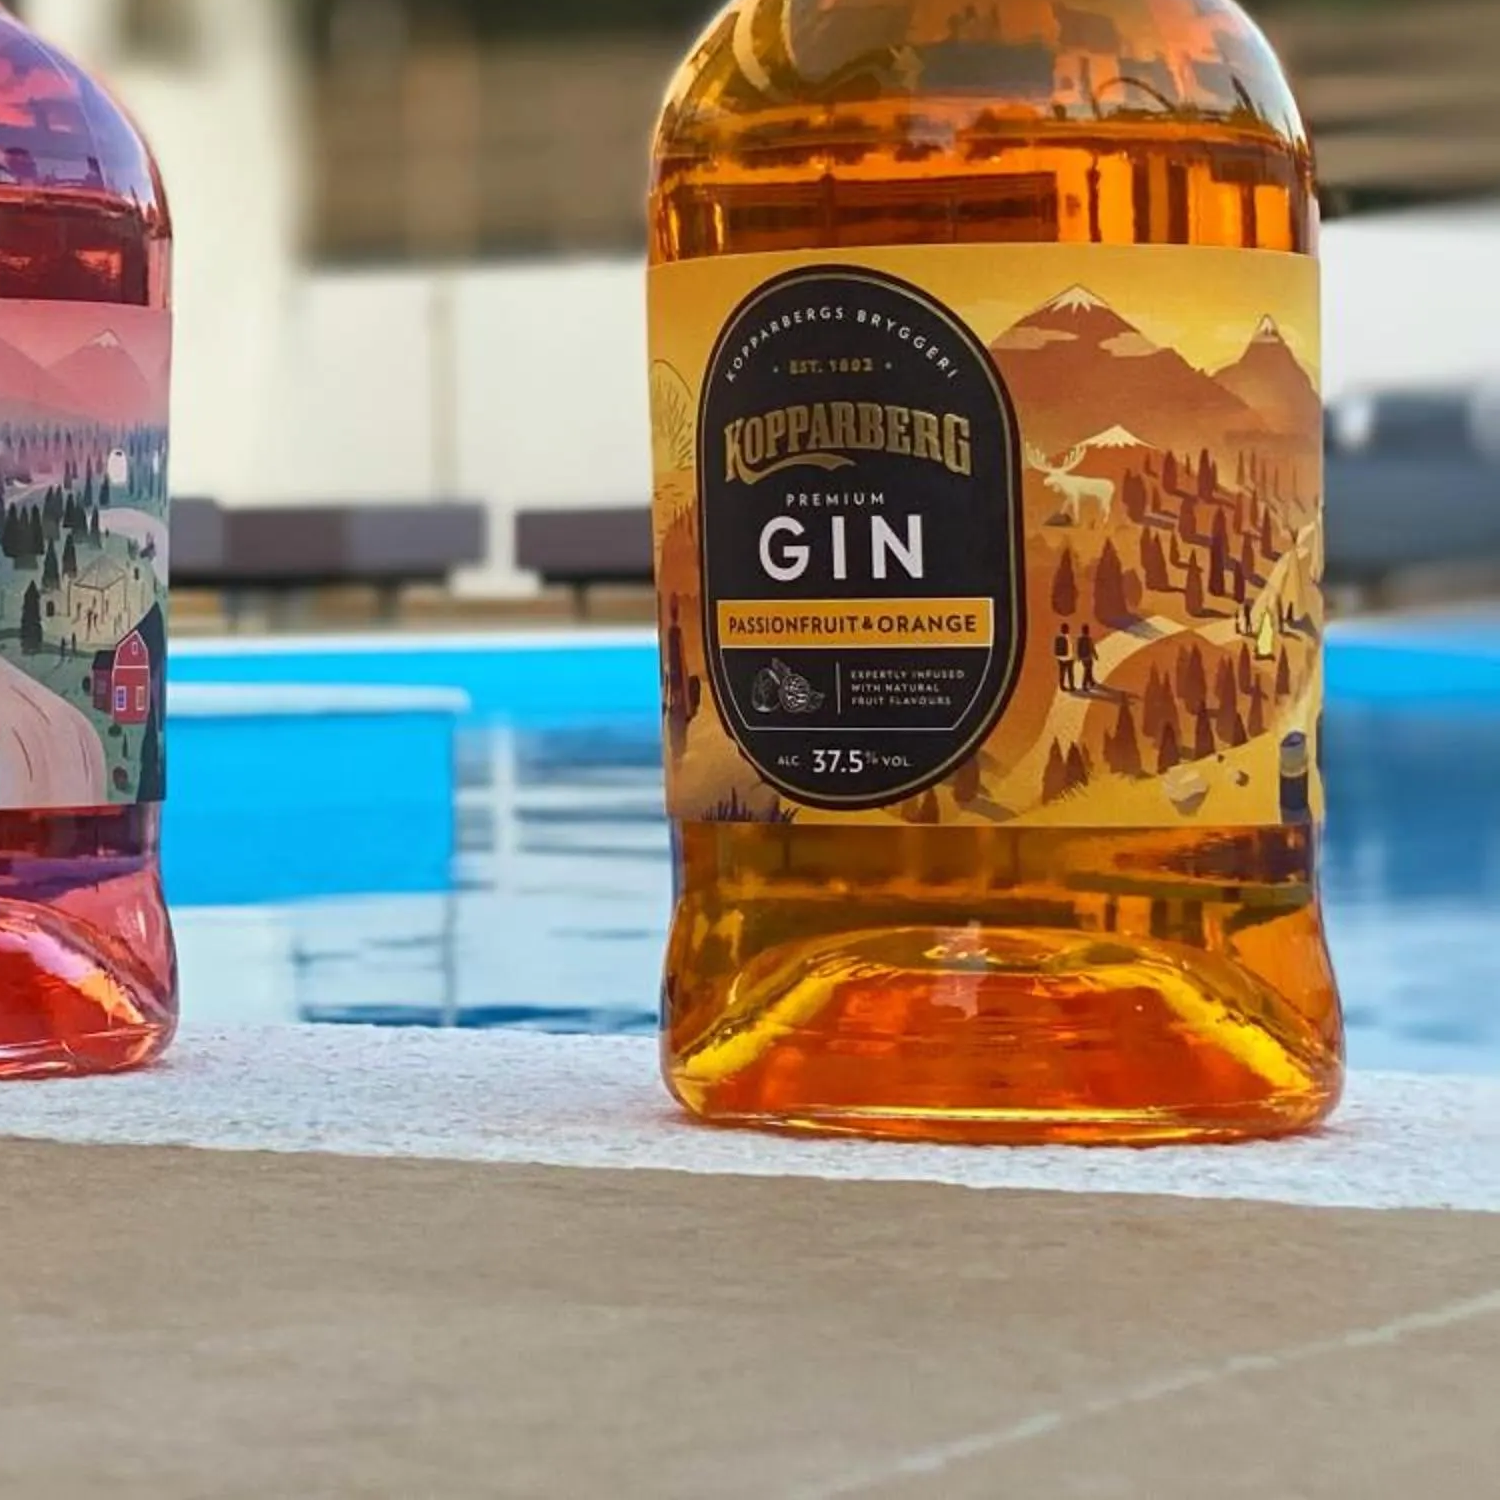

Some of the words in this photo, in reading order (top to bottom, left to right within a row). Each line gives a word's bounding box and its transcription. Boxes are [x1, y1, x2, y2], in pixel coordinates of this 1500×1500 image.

[725, 306, 844, 383] KOPPARBERGS
[856, 308, 959, 379] BRYGGERI
[723, 401, 972, 486] KOPPARBERG
[786, 492, 885, 507] PREMIUM
[759, 514, 924, 582] GIN
[851, 683, 881, 693] WITH
[885, 683, 940, 693] NATURAL
